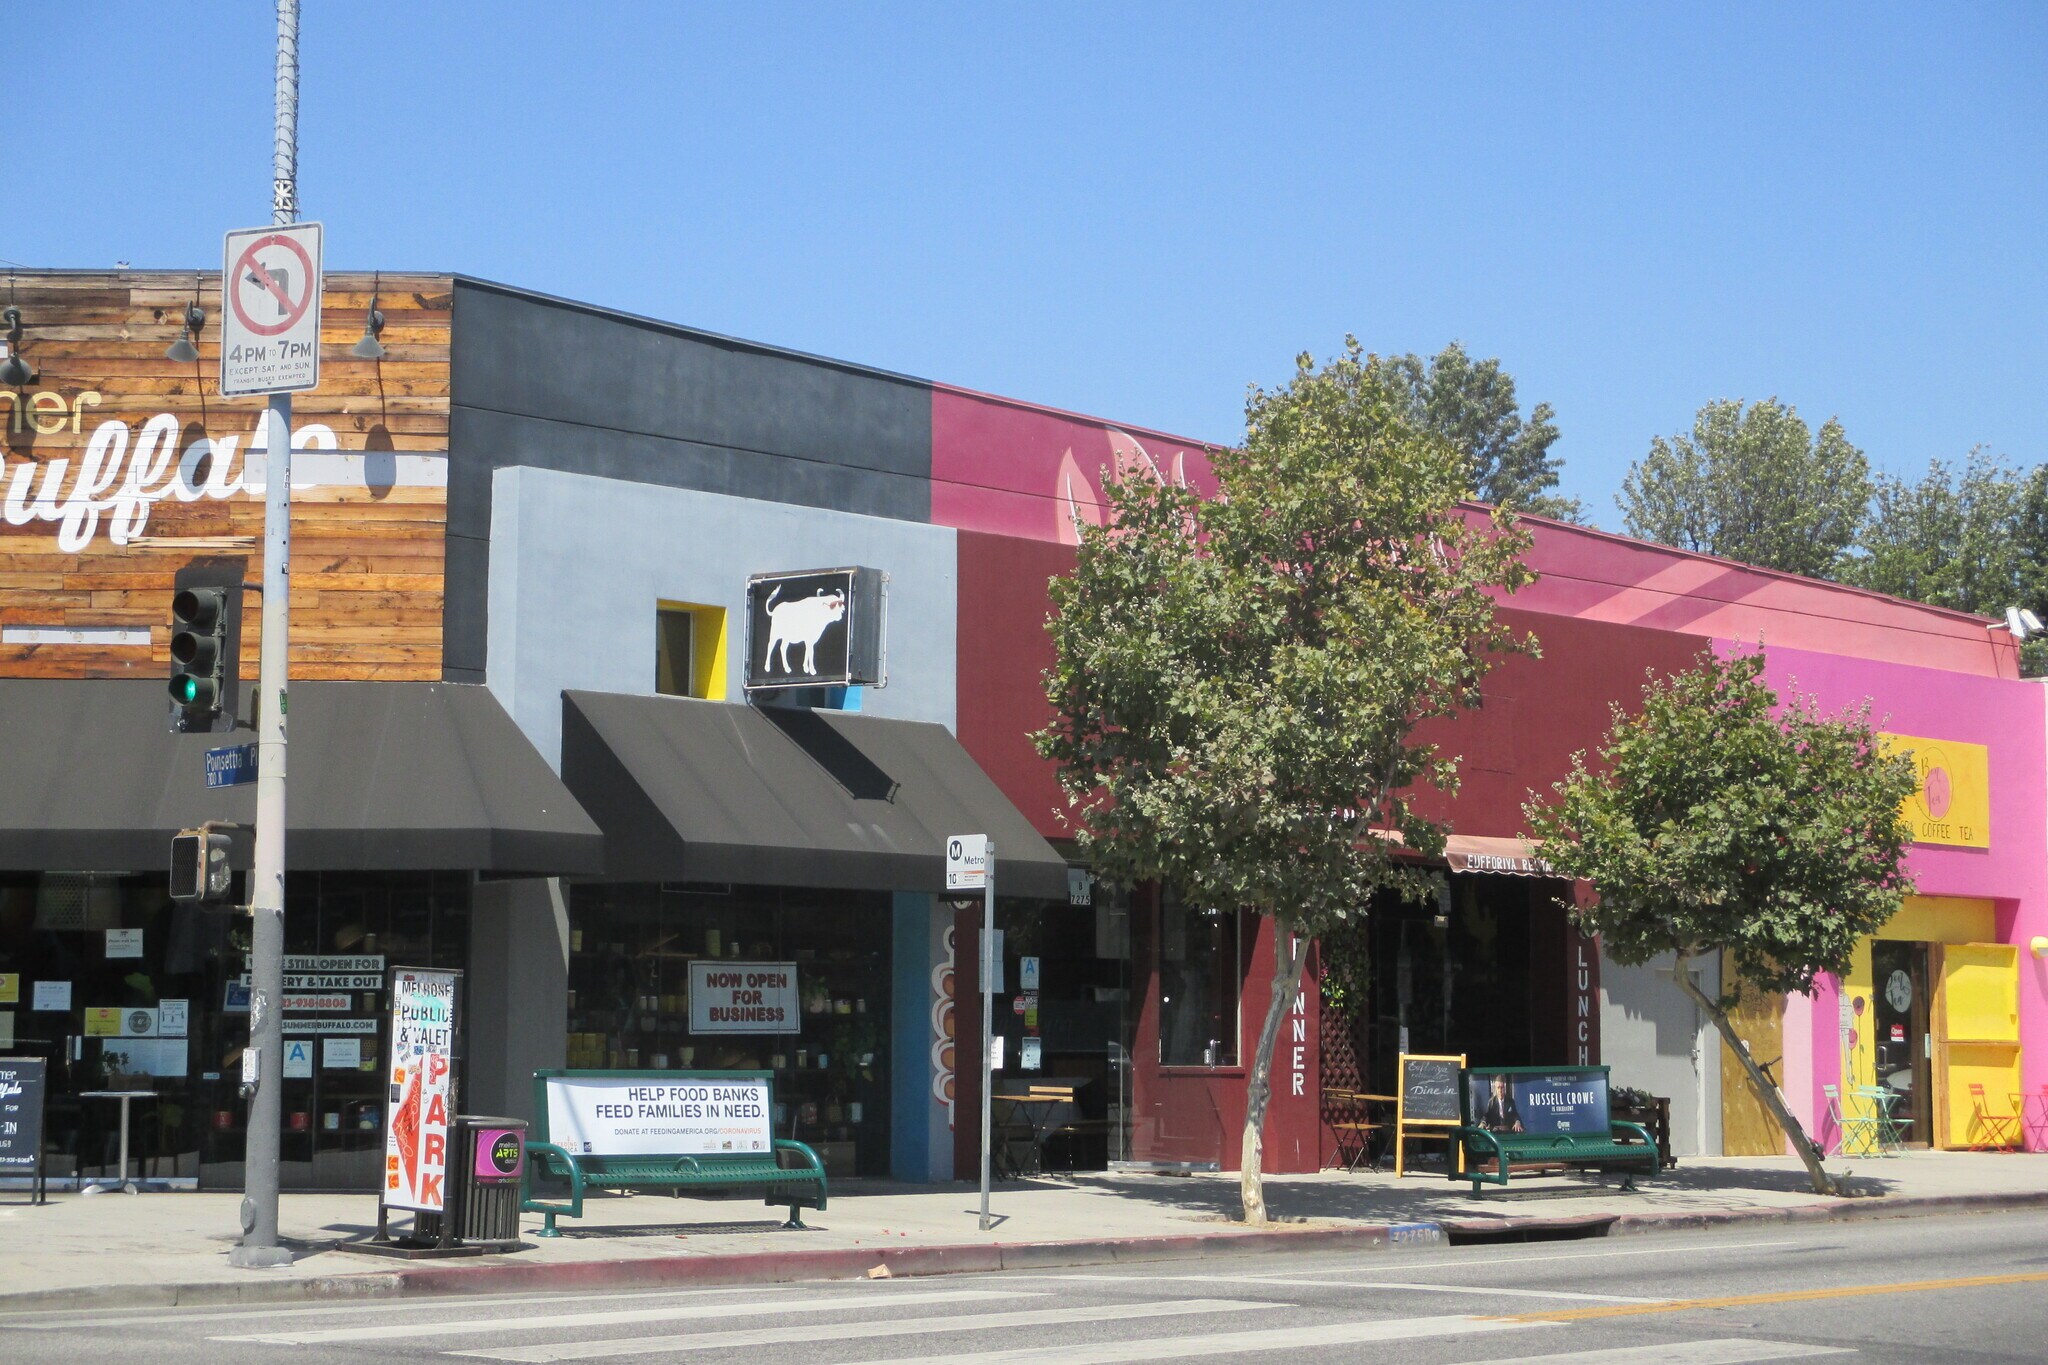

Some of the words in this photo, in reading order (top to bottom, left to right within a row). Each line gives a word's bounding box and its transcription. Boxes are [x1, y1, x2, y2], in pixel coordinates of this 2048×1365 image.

[268, 349, 277, 357] TO
[229, 366, 259, 376] EXCEPT
[280, 363, 292, 371] AND
[233, 377, 255, 385] TRANSIT
[278, 373, 306, 381] EXEMPTED
[206, 750, 243, 772] Poinsettia
[207, 772, 217, 786] 700
[1922, 822, 1951, 839] COFFEE
[1959, 826, 1974, 841] TEA
[964, 856, 985, 865] Metro
[1467, 854, 1517, 870] EUFFORIYA
[949, 873, 957, 885] 10
[1078, 881, 1084, 891] B
[1071, 895, 1091, 905] 7275
[288, 958, 317, 969] STILL
[319, 959, 352, 969] OPEN
[355, 959, 380, 969] FOR
[1025, 959, 1035, 974] A
[307, 977, 317, 988] &
[319, 977, 349, 987] TAKE
[353, 977, 378, 987] OUT
[706, 973, 742, 988] NOW
[746, 973, 787, 988] OPEN
[732, 990, 763, 1005] FOR
[1578, 945, 1589, 1067] LUNCH
[401, 1005, 449, 1022] PUBLIC
[709, 1007, 785, 1022] BUSINESS
[400, 1027, 409, 1043] &
[1891, 1027, 1903, 1036] Open
[288, 1042, 306, 1061] A
[628, 1088, 665, 1101] HELP
[670, 1088, 709, 1101] FOOD
[713, 1088, 759, 1101] BANKS
[1410, 1085, 1440, 1095] Dine
[1443, 1085, 1458, 1095] in
[1529, 1093, 1564, 1106] RUSSELL
[1567, 1092, 1594, 1105] CROWE
[596, 1104, 633, 1118] FEED
[638, 1104, 702, 1118] FAMILIES
[706, 1104, 720, 1118] IN
[724, 1104, 765, 1118] NEED.
[420, 1053, 449, 1206] PARK
[614, 1128, 640, 1136] DONATE
[650, 1127, 762, 1136] FEEDINGAMERICA.ORG/CORONAVIRUS
[496, 1149, 518, 1158] ARTS
